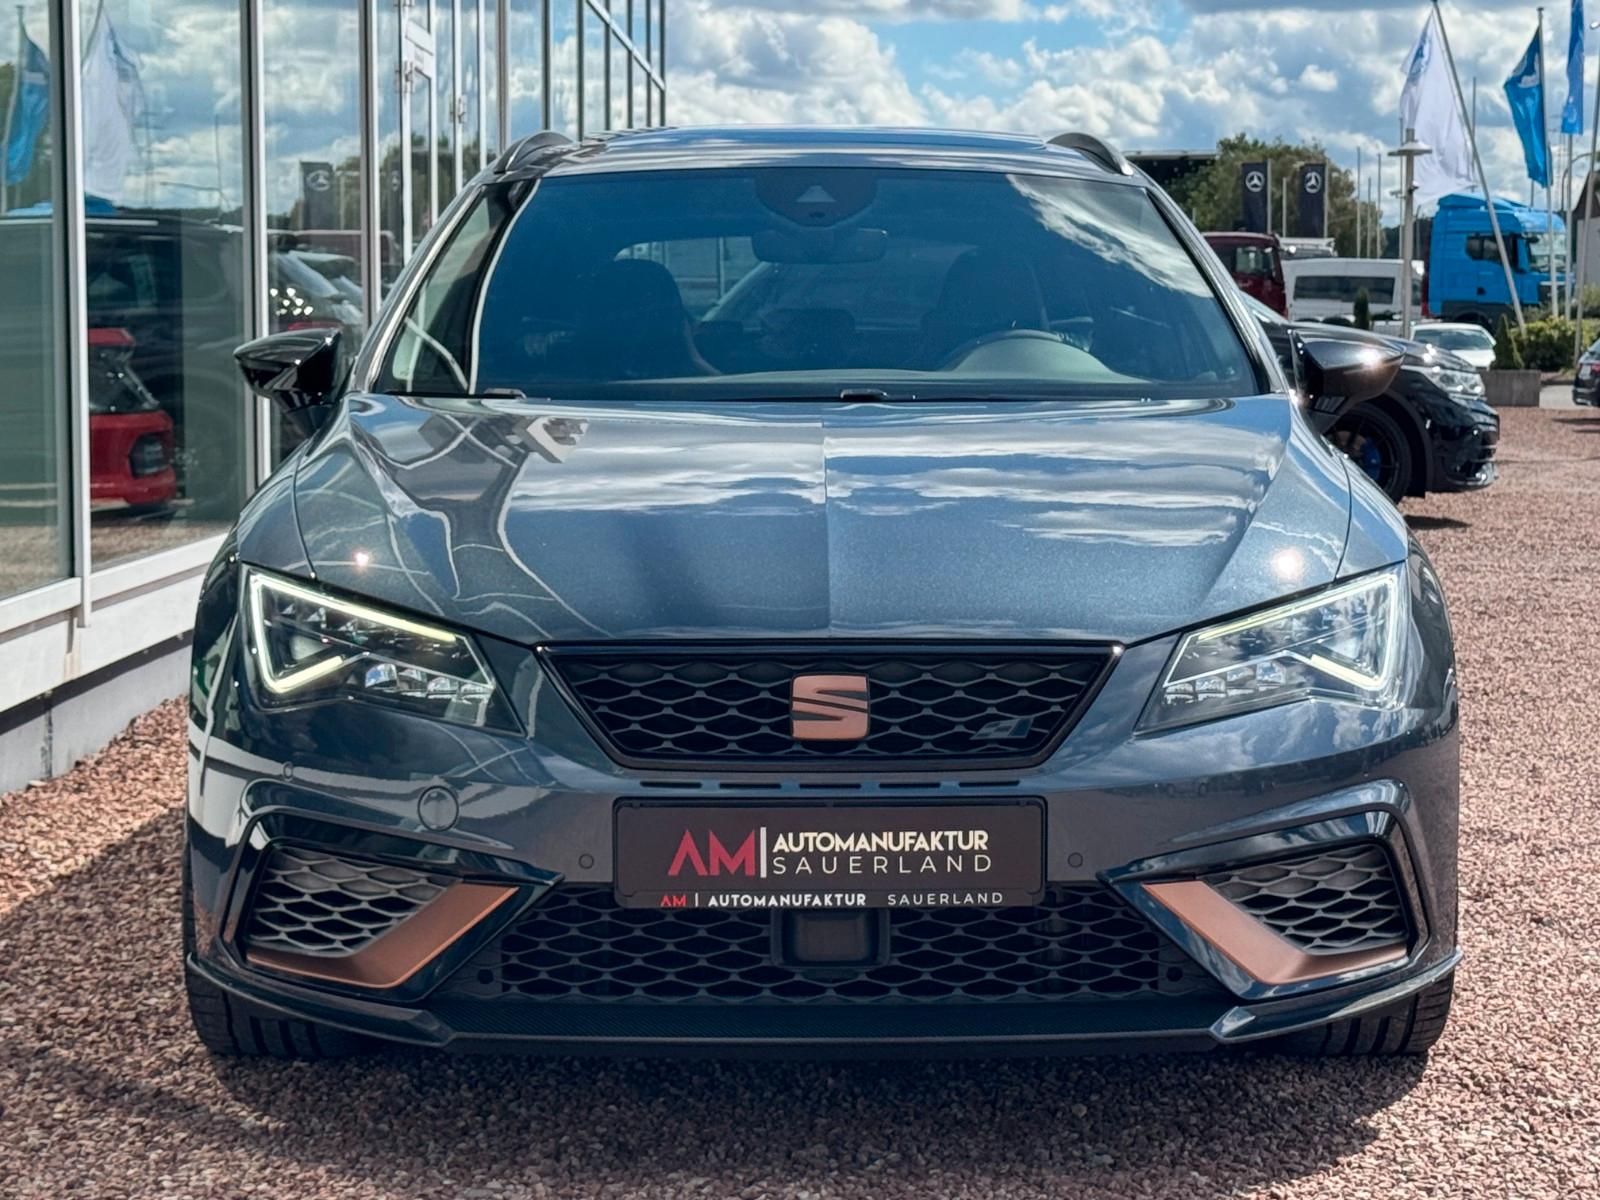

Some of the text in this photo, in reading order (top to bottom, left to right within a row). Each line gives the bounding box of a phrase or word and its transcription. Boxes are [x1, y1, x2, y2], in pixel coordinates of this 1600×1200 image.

[773, 830, 989, 853] AUTOMANUFAKTUR
[668, 829, 756, 876] AM
[773, 855, 992, 875] SAUERLAND
[660, 892, 1003, 907] AM AUTOMANUFAKTUR SAUERLAND
